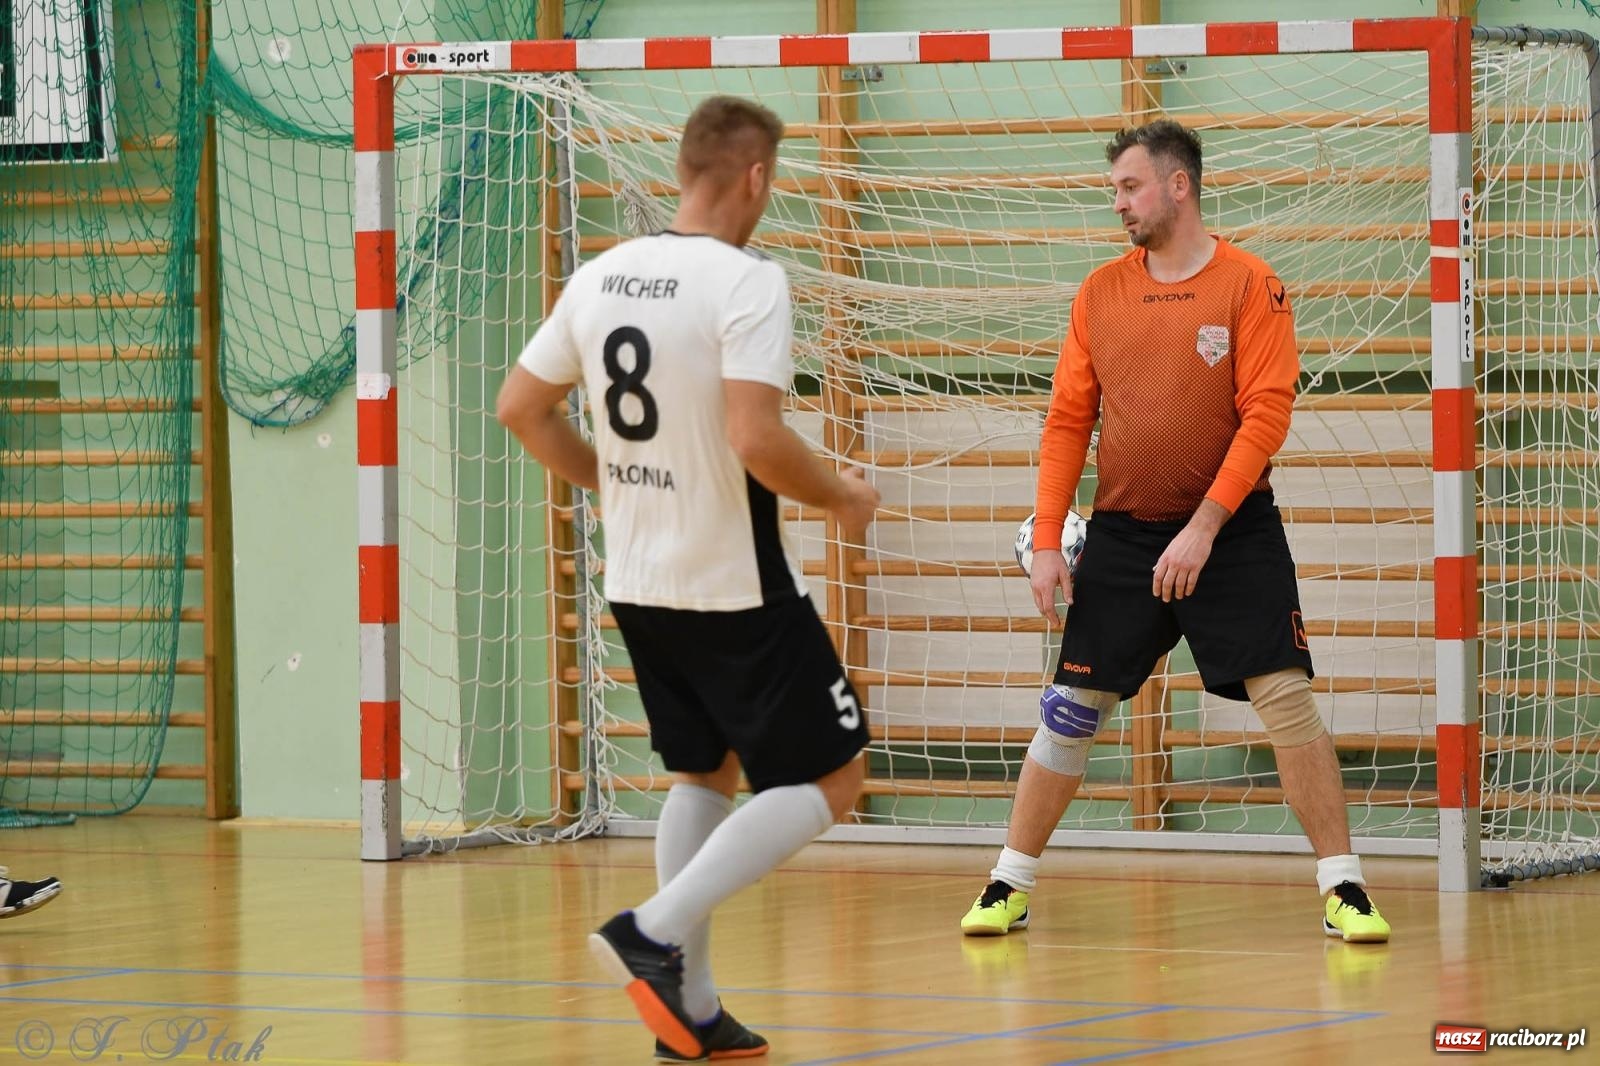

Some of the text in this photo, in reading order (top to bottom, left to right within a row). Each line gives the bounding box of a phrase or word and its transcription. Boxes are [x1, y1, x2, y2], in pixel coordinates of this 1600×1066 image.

[449, 49, 489, 66] sport
[601, 274, 680, 300] WICHER
[1142, 292, 1197, 304] GIVOVA
[603, 326, 660, 442] 8
[828, 676, 861, 731] 5
